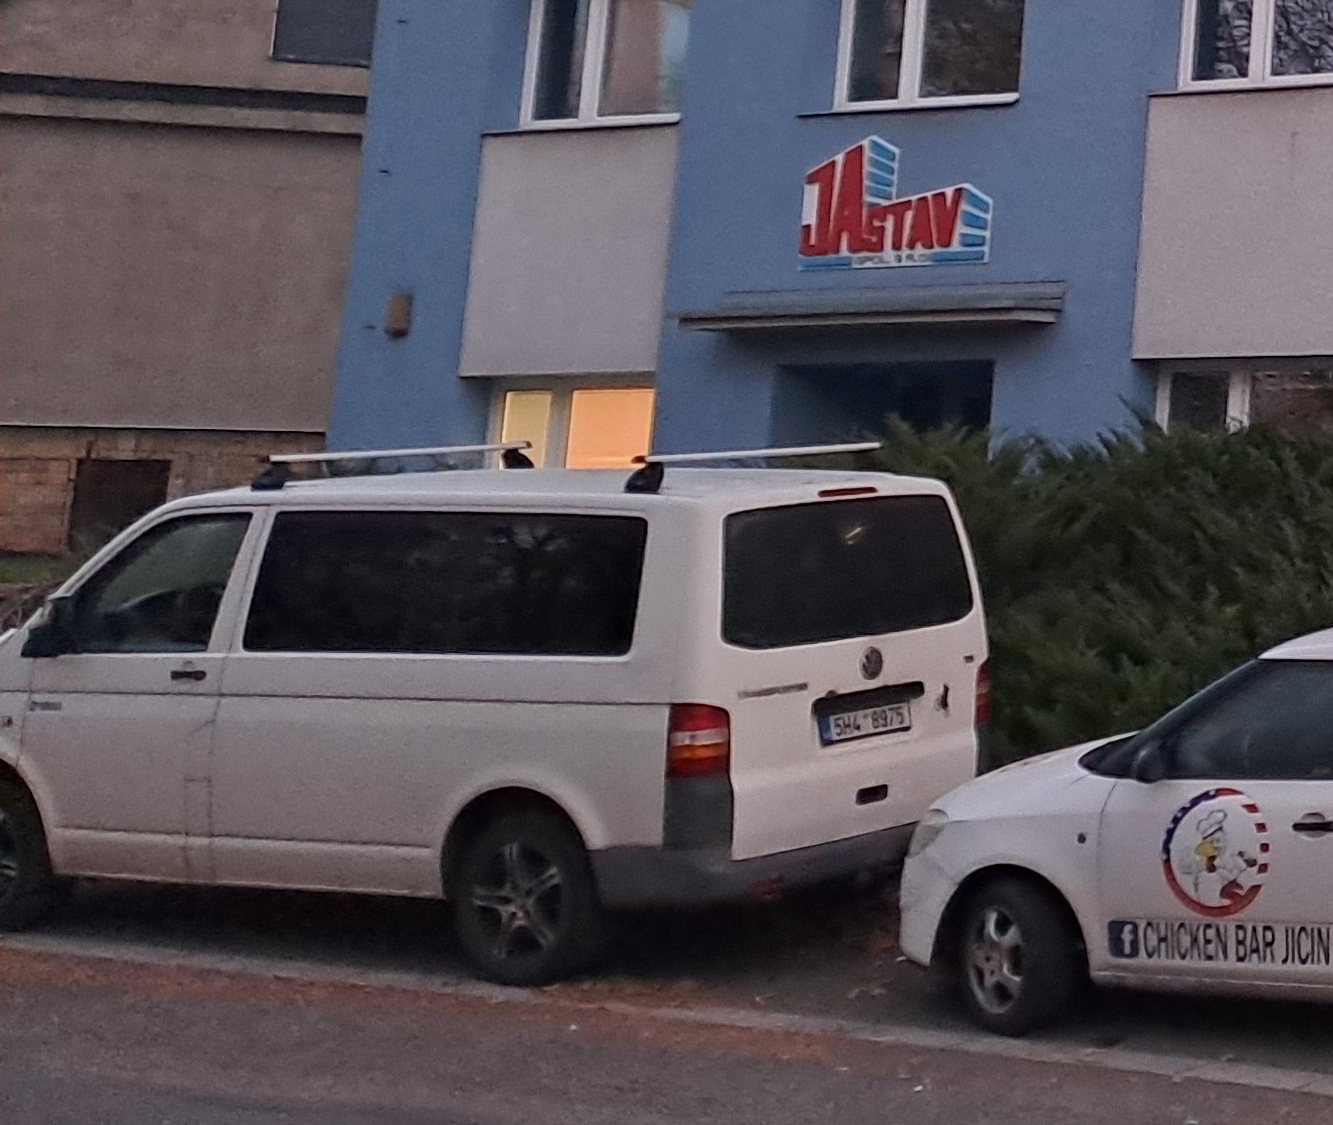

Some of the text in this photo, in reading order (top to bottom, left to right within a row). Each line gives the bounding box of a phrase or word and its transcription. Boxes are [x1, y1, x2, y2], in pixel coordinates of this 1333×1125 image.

[798, 143, 963, 257] JASTAV
[1143, 921, 1229, 962] CHICKEN
[1234, 924, 1276, 963] BAR
[1281, 925, 1331, 966] JICIN
